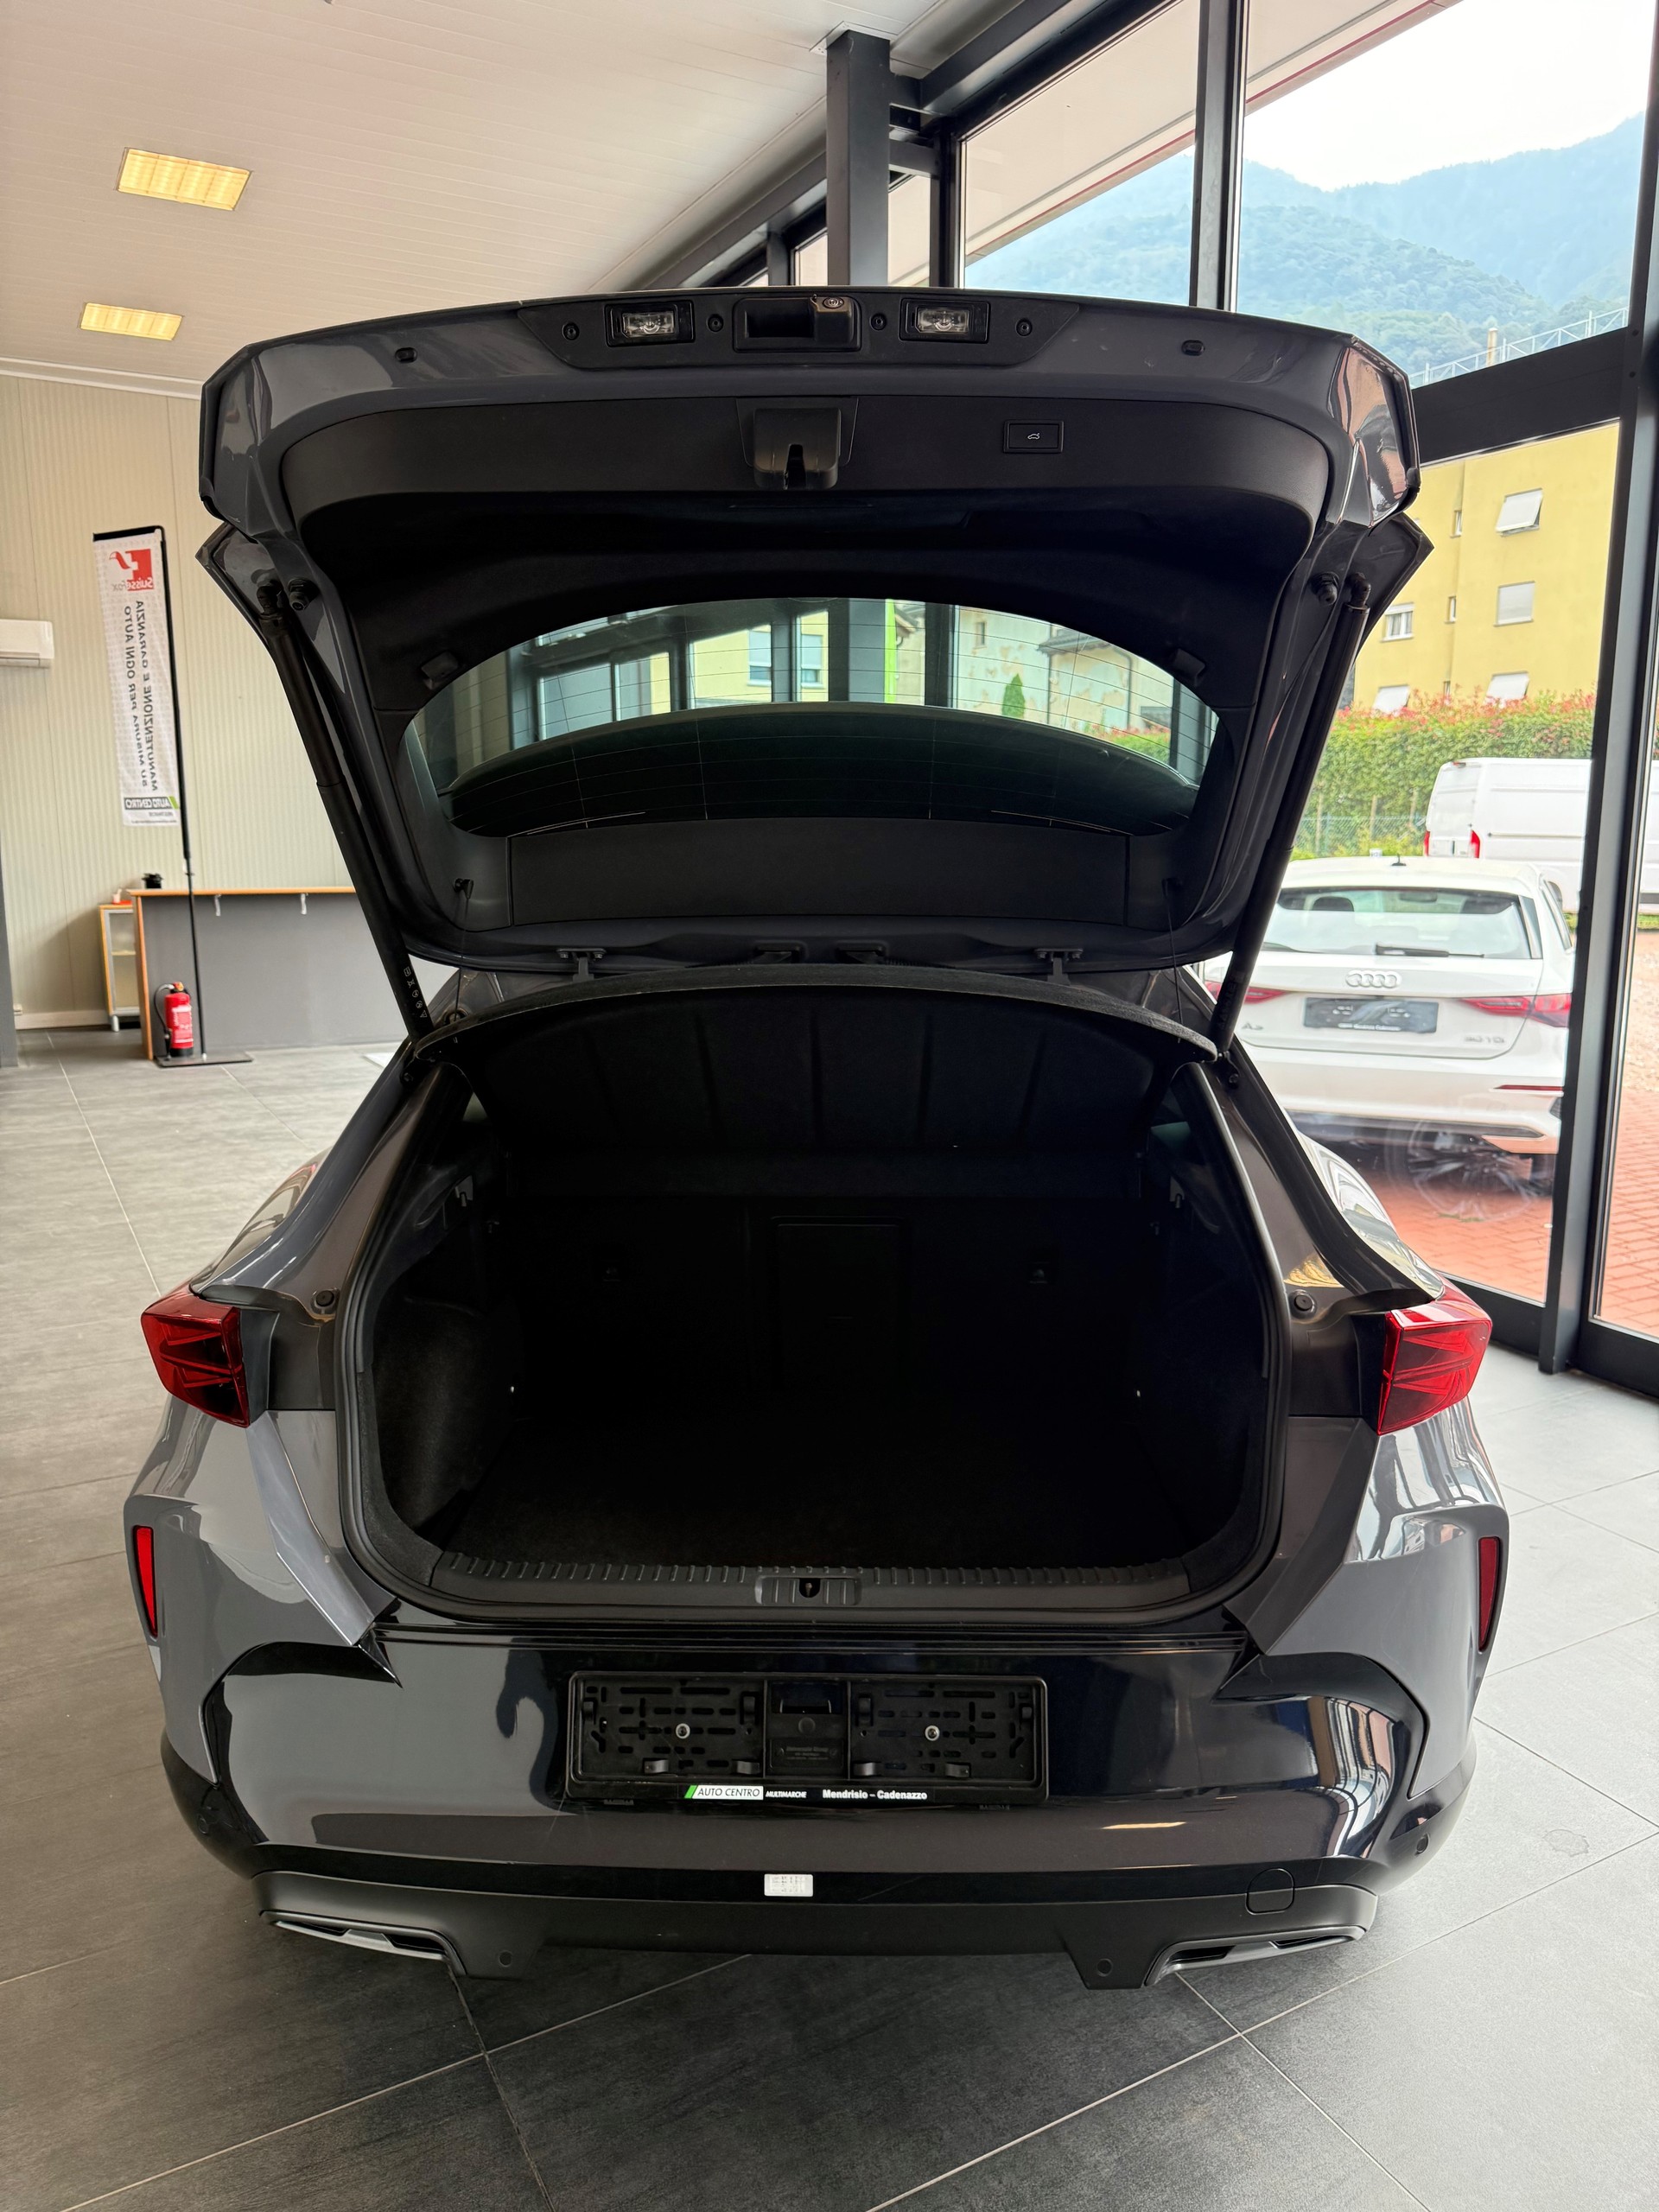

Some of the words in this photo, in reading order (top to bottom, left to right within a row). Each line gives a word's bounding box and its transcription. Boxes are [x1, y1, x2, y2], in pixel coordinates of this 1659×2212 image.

[697, 1788, 723, 1796] AUTO
[725, 1789, 760, 1797] CENTRO
[822, 1789, 868, 1800] Mendrisio
[876, 1789, 928, 1800] Cadenazzo
